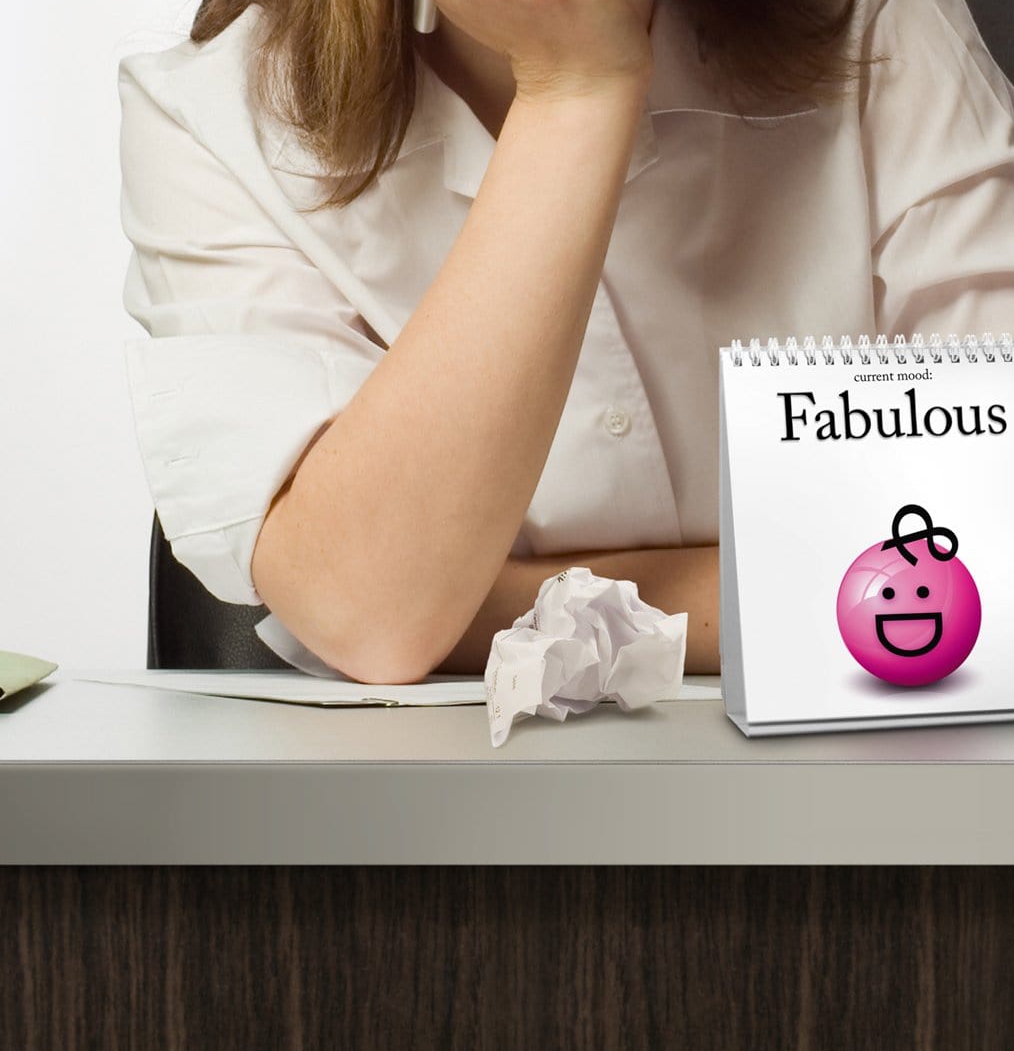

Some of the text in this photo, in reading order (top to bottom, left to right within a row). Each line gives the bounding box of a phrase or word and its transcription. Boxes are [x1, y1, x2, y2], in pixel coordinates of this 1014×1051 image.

[853, 368, 933, 382] current mood:
[777, 387, 1008, 441] Fabulous
